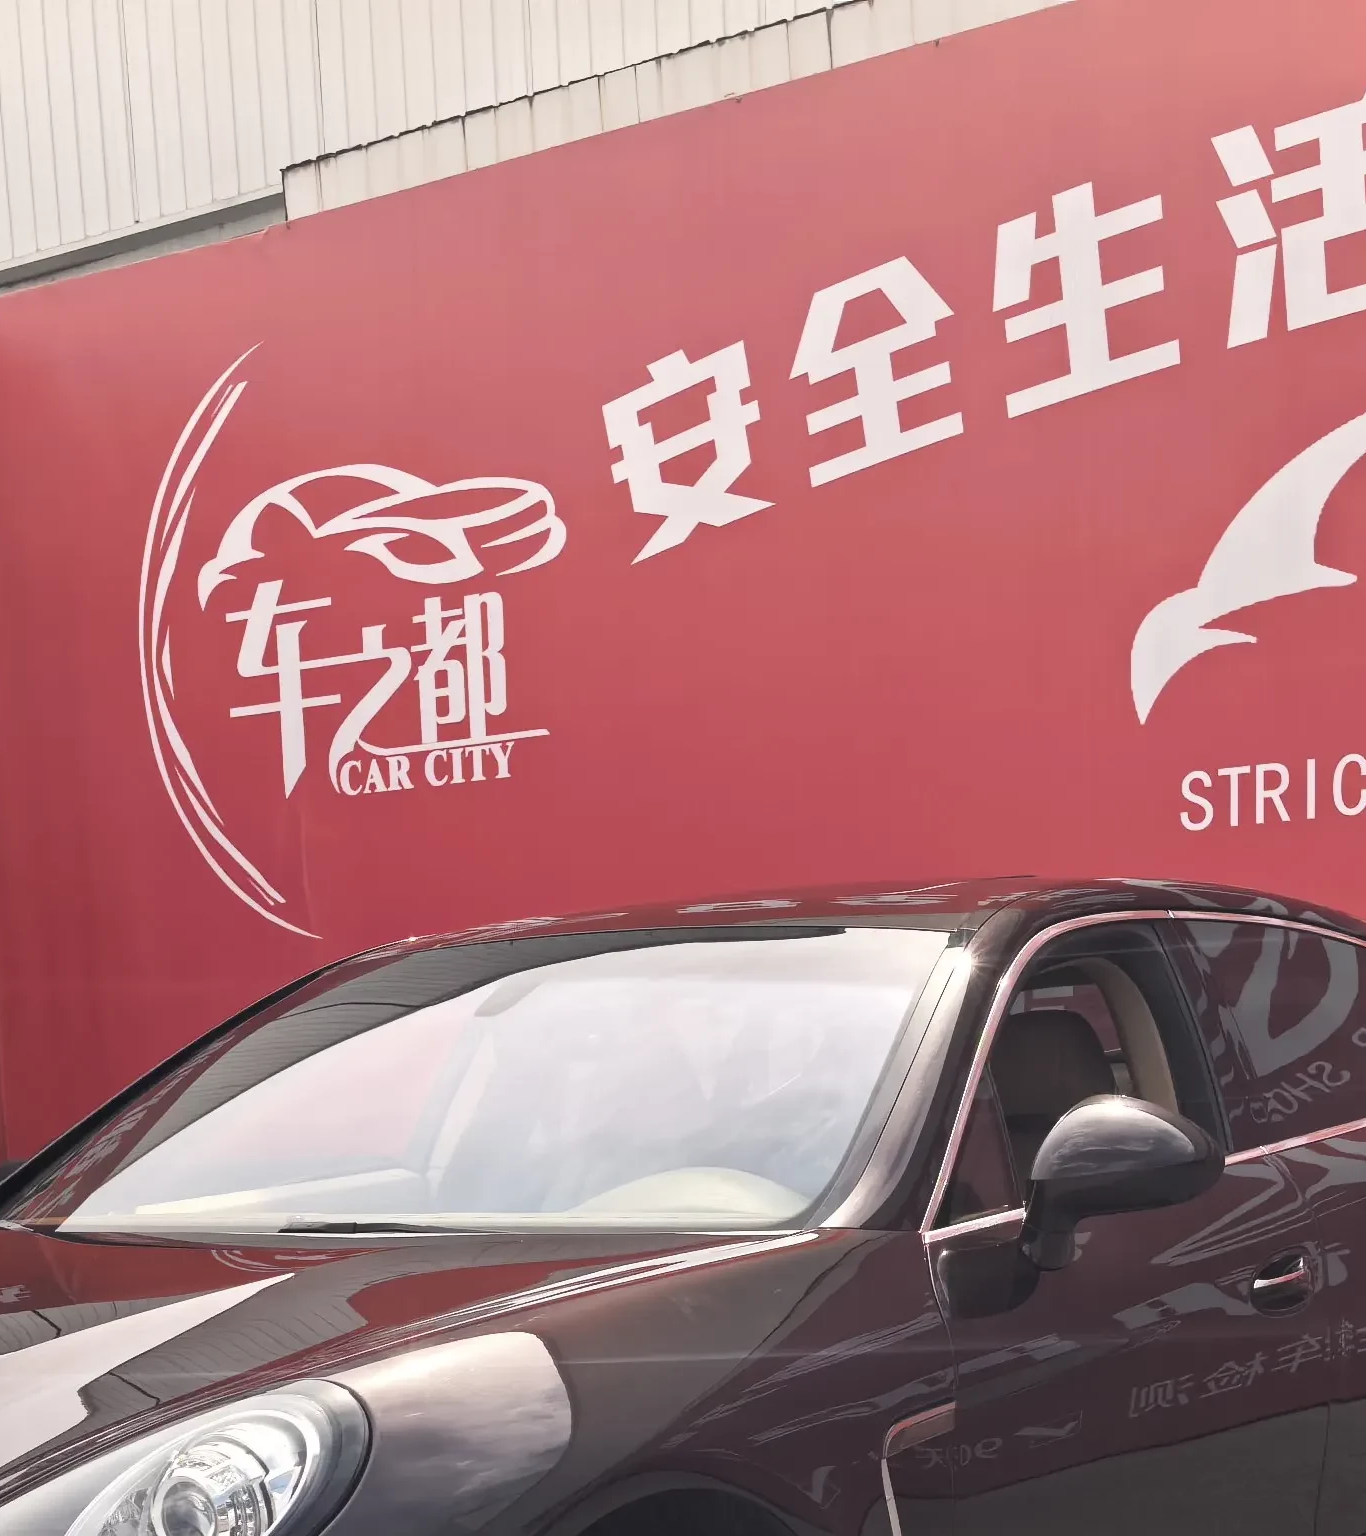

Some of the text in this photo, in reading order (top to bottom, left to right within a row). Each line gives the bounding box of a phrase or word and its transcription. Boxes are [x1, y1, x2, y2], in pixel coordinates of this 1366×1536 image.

[225, 579, 550, 800] 车之都
[339, 741, 515, 796] CAR CITY
